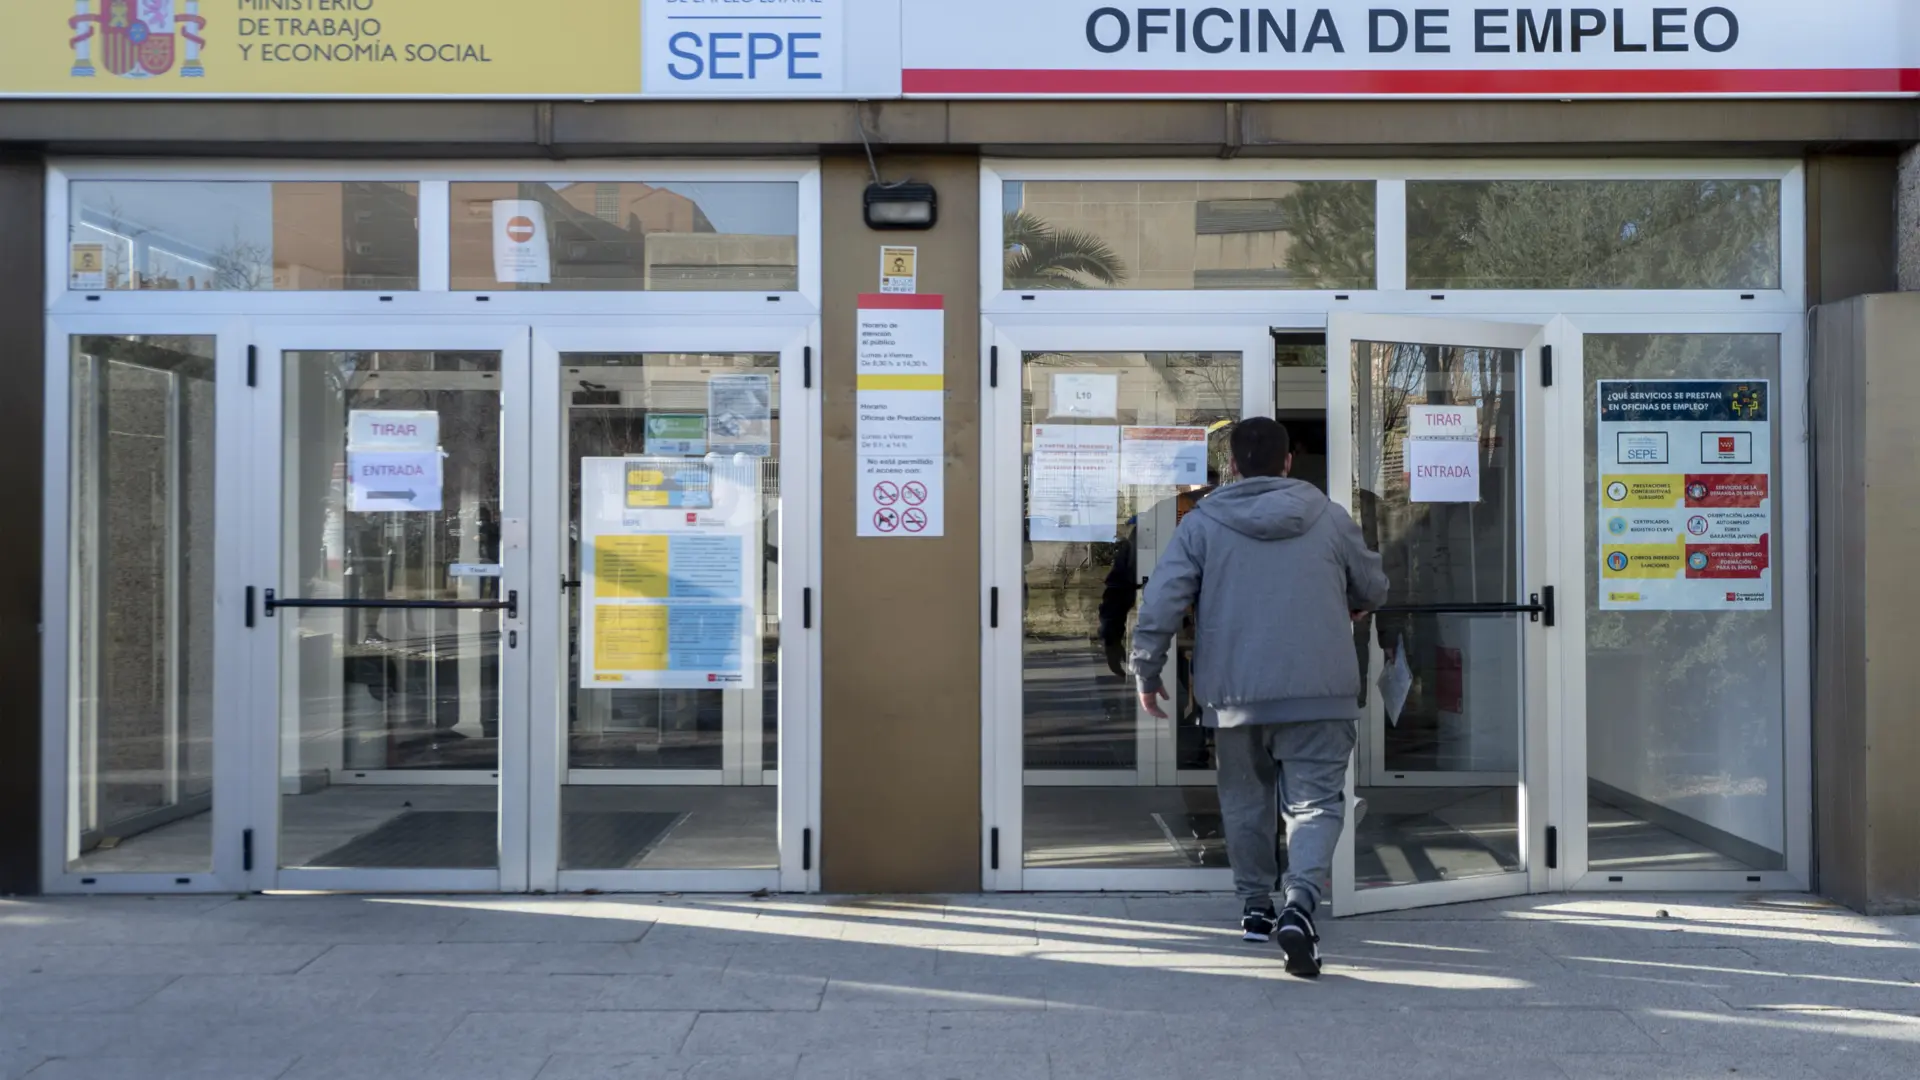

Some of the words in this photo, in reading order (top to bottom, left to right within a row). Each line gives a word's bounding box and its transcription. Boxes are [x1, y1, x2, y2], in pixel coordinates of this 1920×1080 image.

[238, 18, 270, 36] DE
[274, 18, 381, 41] TRABAJO
[1085, 6, 1345, 54] OFICINA
[1368, 7, 1451, 53] DE
[1474, 6, 1740, 54] EMPLEO
[238, 44, 253, 62] Y
[261, 39, 398, 62] ECONOMÍA
[404, 44, 492, 62] SOCIAL
[667, 31, 823, 81] SEPE
[1076, 391, 1092, 400] L10
[1630, 392, 1673, 400] SERVICIOS
[1674, 392, 1683, 400] SE
[1685, 392, 1722, 400] PRESTAN
[1608, 403, 1620, 411] EN
[1621, 403, 1660, 411] OFICINAS
[1661, 403, 1672, 411] DE
[1674, 403, 1709, 411] EMPLEO?
[1425, 414, 1462, 425] TIRAR
[371, 424, 418, 436] TIRAR
[1627, 449, 1658, 460] SEPE
[897, 458, 934, 466] permitido
[362, 464, 424, 476] ENTRADA
[1417, 465, 1472, 477] ENTRADA
